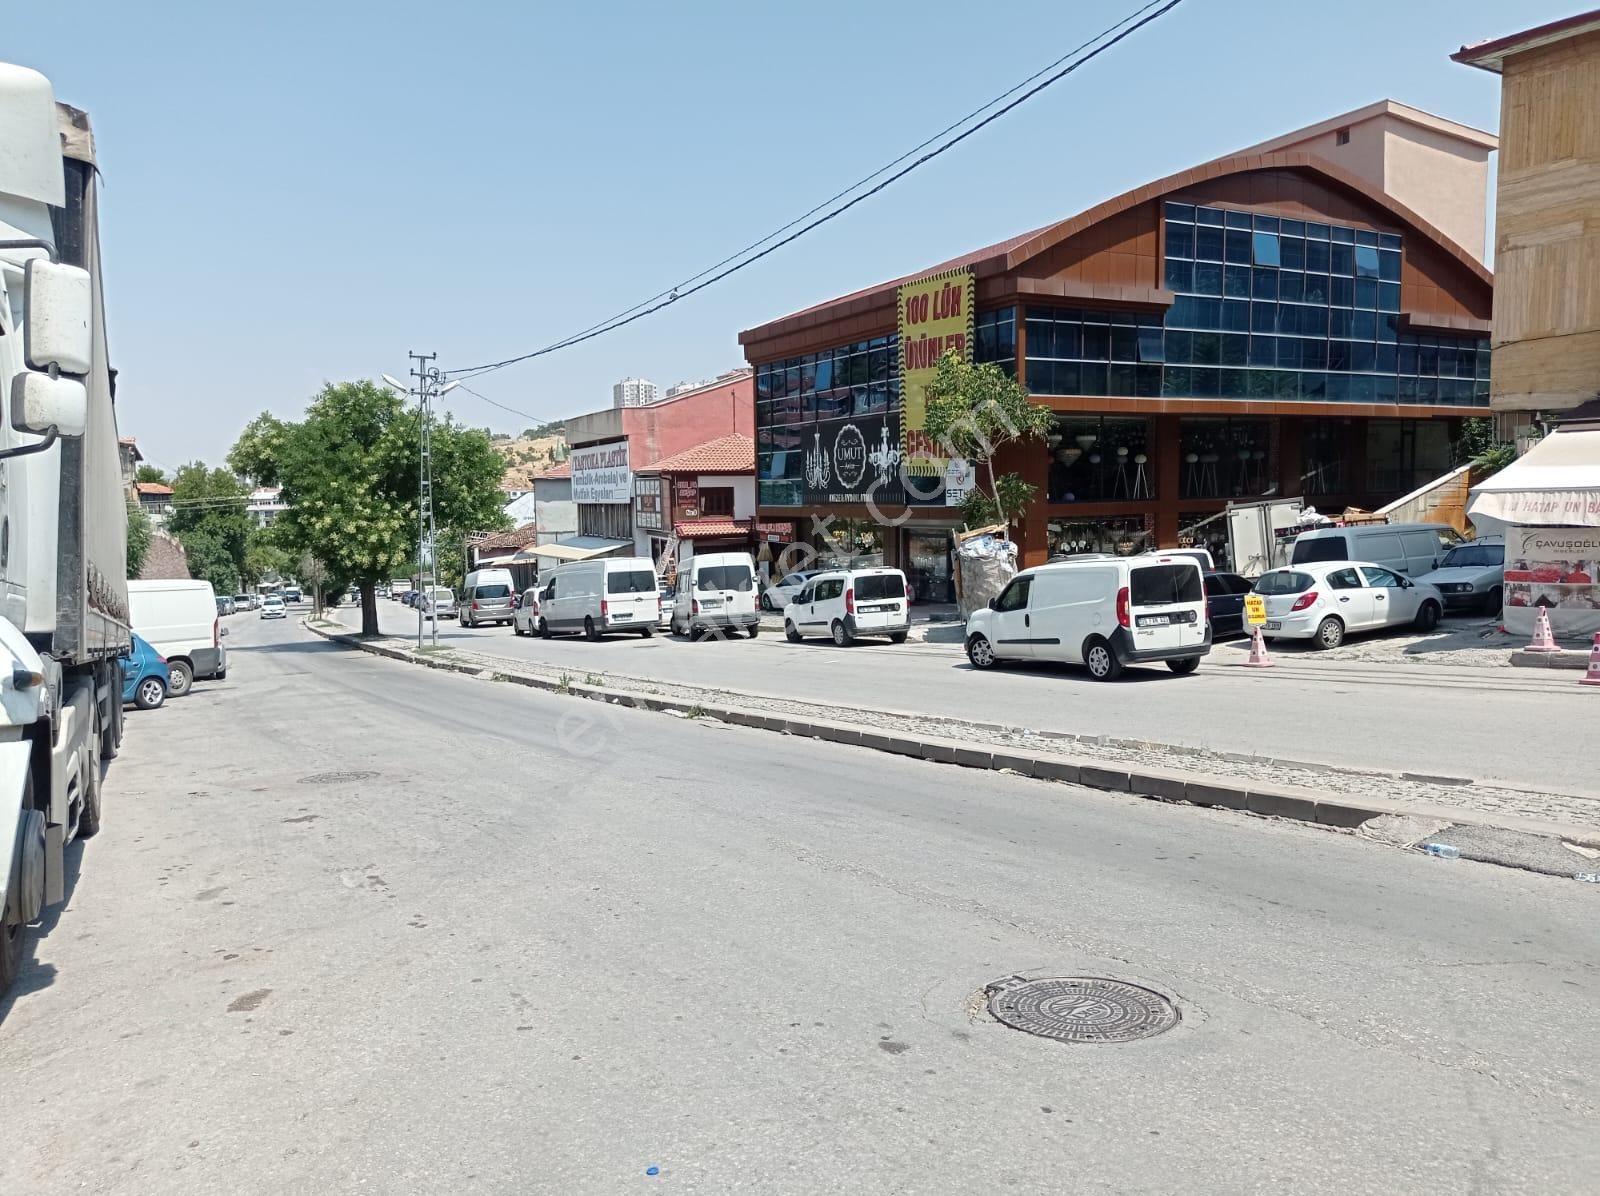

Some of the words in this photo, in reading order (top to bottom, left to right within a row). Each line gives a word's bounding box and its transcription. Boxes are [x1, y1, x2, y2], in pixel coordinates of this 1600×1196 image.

[906, 293, 929, 325] 100
[837, 447, 862, 461] UMUT
[1523, 502, 1559, 513] HATAP
[1565, 502, 1581, 512] UN
